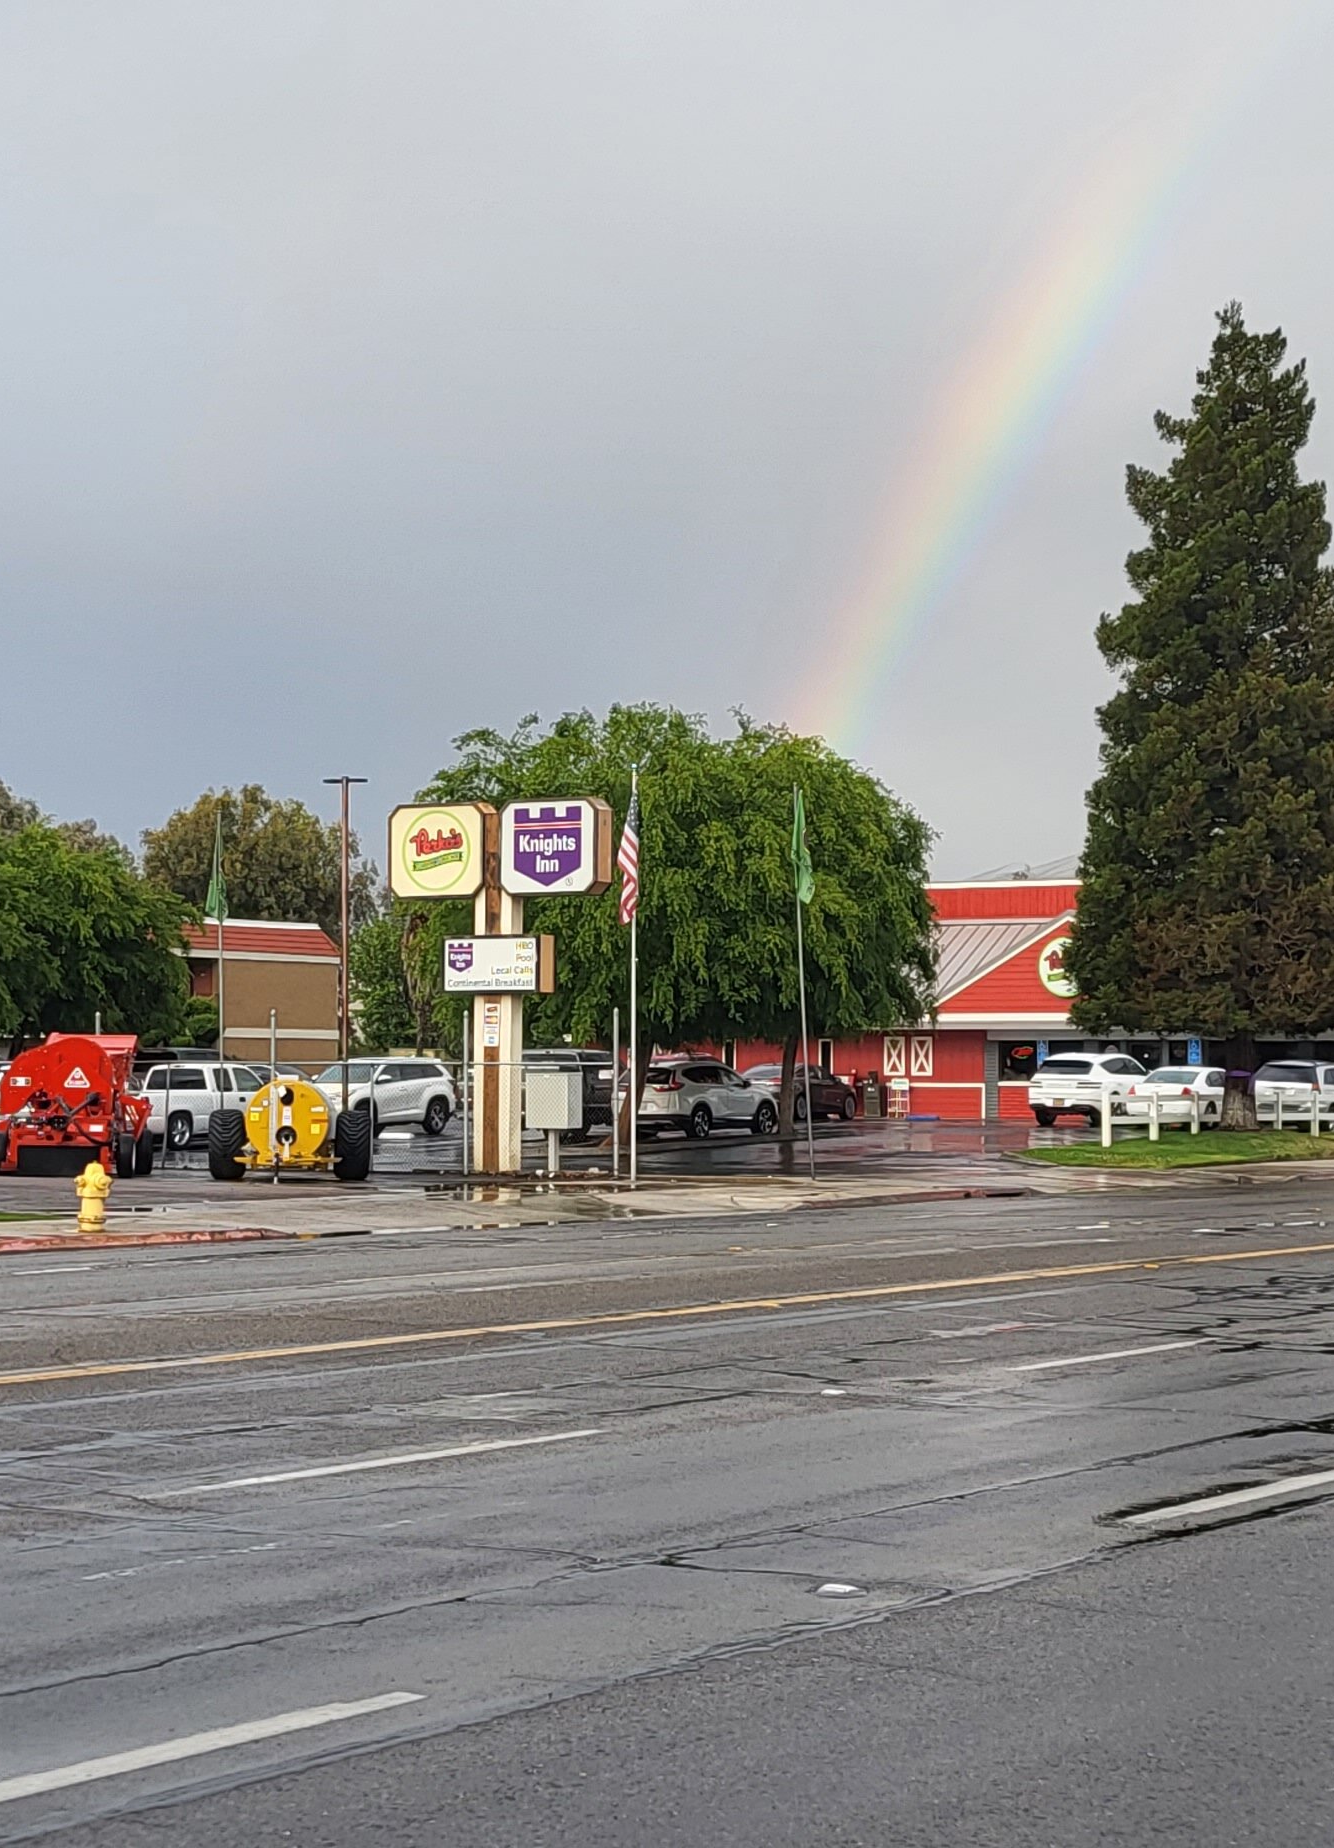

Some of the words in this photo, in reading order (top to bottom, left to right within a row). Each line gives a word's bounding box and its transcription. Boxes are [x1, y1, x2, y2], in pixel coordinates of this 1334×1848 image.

[519, 833, 576, 856] Knights
[536, 854, 559, 873] Inn
[515, 941, 534, 950] HBO
[515, 953, 534, 962] Pool
[490, 965, 512, 975] Local
[513, 965, 534, 975] Calls
[447, 979, 494, 988] Continental
[495, 978, 533, 987] Breakfast
